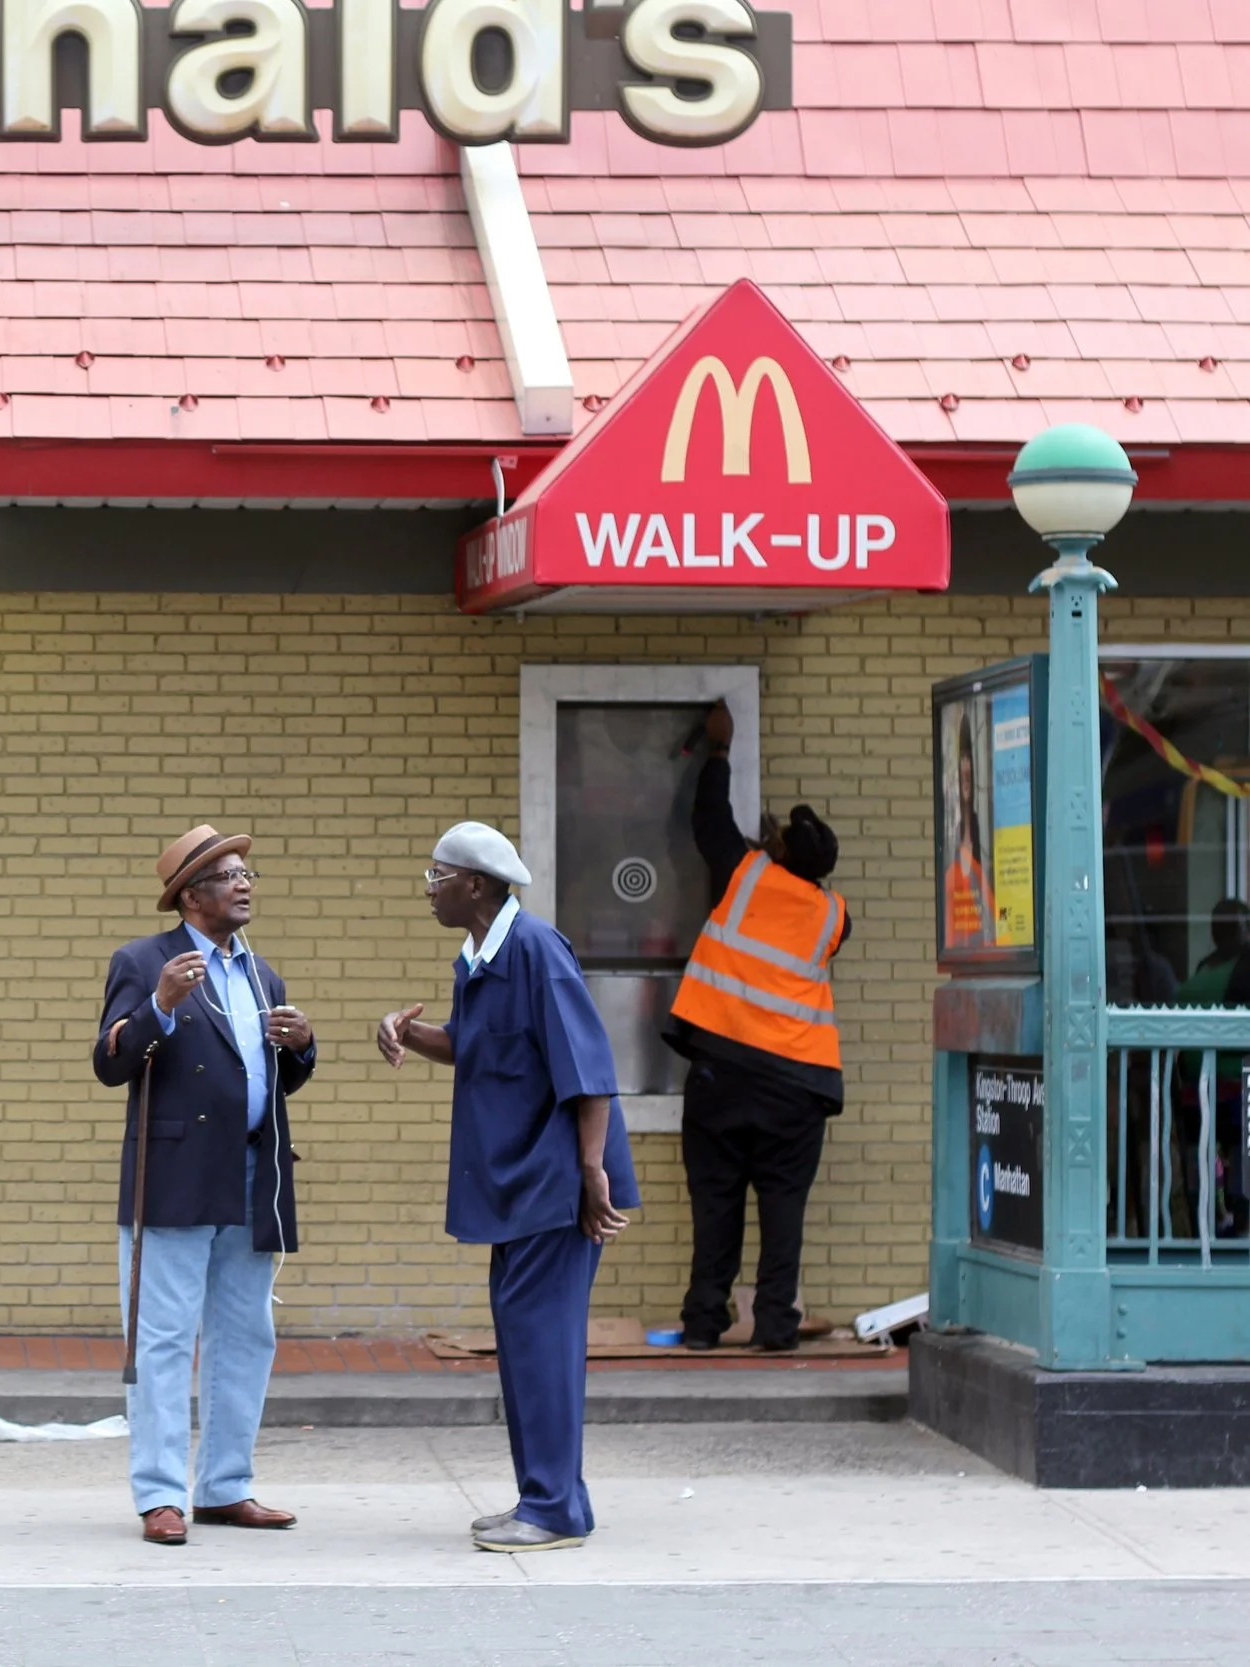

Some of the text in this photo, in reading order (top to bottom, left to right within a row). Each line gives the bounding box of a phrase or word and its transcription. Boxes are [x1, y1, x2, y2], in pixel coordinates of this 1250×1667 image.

[661, 355, 812, 484] M
[575, 512, 896, 570] WALK-UP
[976, 1104, 1000, 1135] Station
[980, 1162, 1030, 1212] C Manhattan
